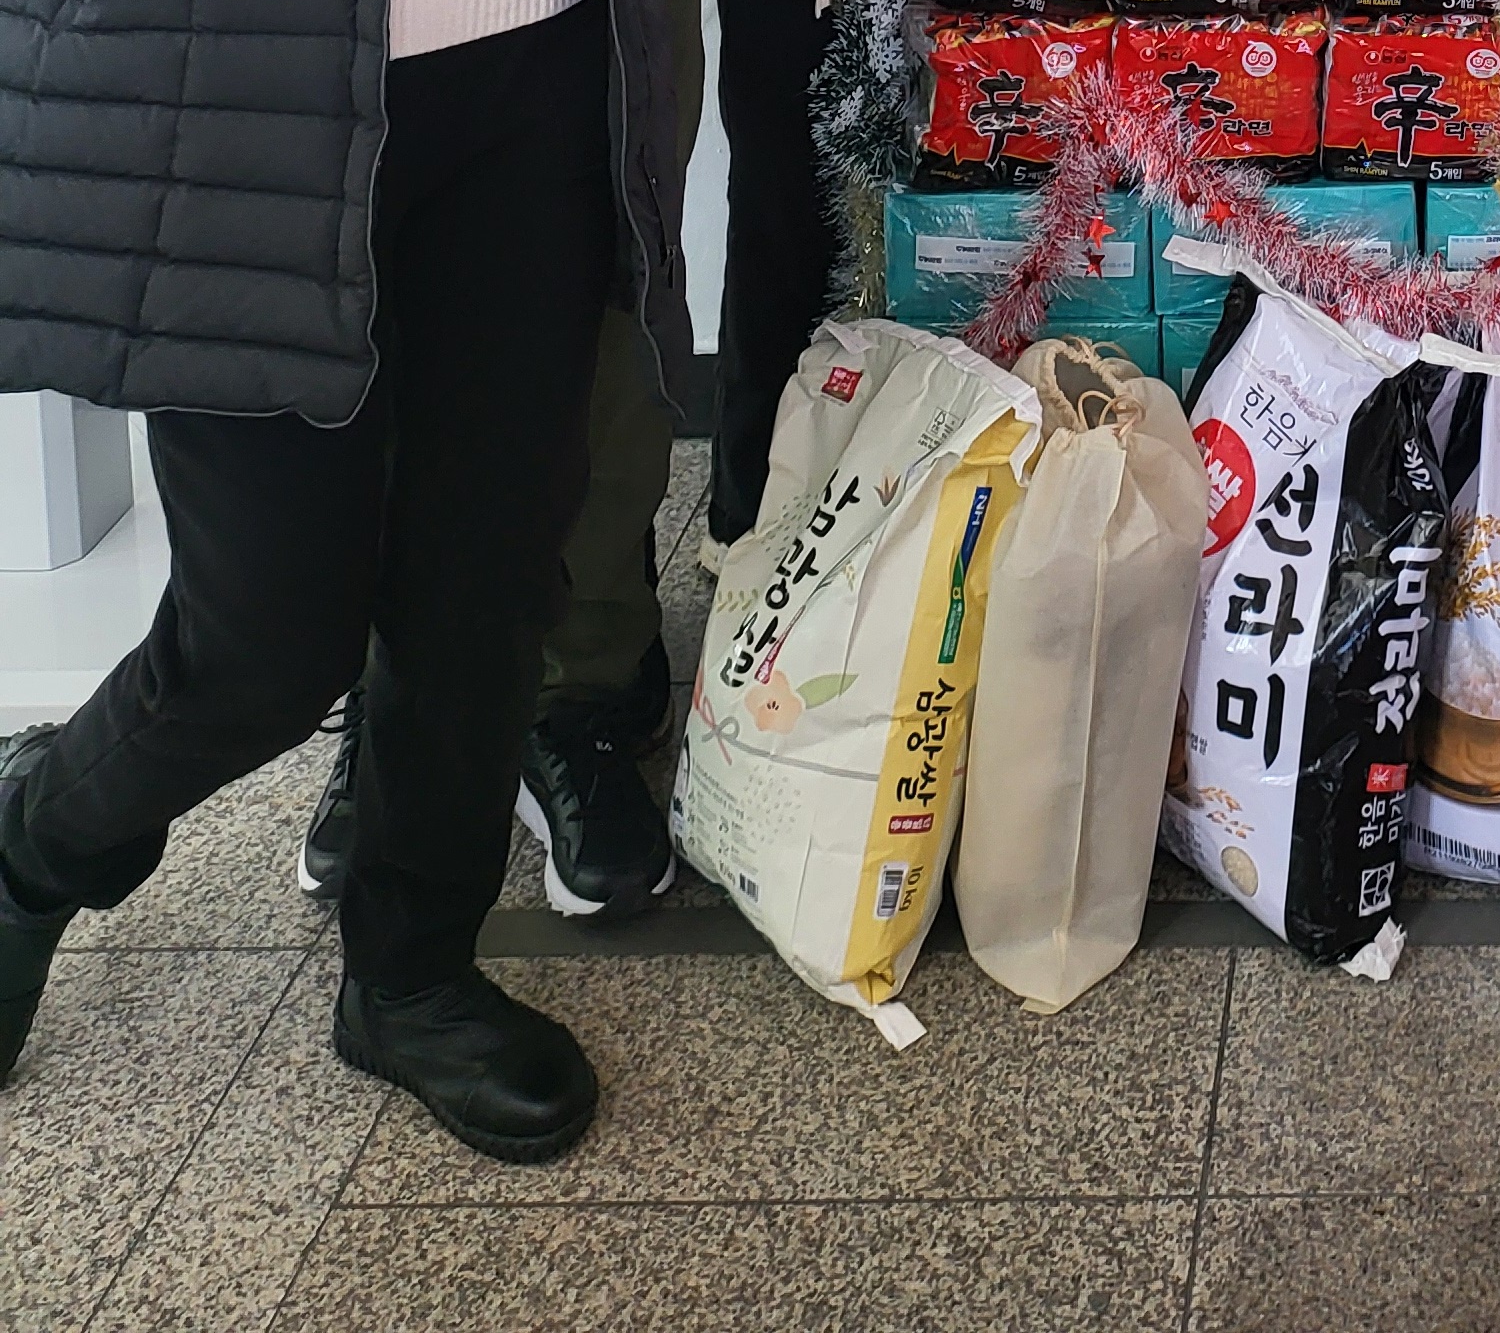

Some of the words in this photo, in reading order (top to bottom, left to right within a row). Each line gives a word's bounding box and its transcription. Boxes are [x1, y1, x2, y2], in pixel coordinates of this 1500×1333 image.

[968, 70, 1045, 170] 辛
[1222, 120, 1273, 136] 라면
[1372, 65, 1460, 168] 辛
[1429, 162, 1462, 180] 5개입
[1404, 437, 1433, 491] 10kg
[719, 468, 861, 688] 삼광쌀
[1370, 547, 1443, 734] 전라미
[896, 678, 956, 808] 삼광쌀
[899, 888, 918, 912] kg
[910, 865, 924, 885] 10
